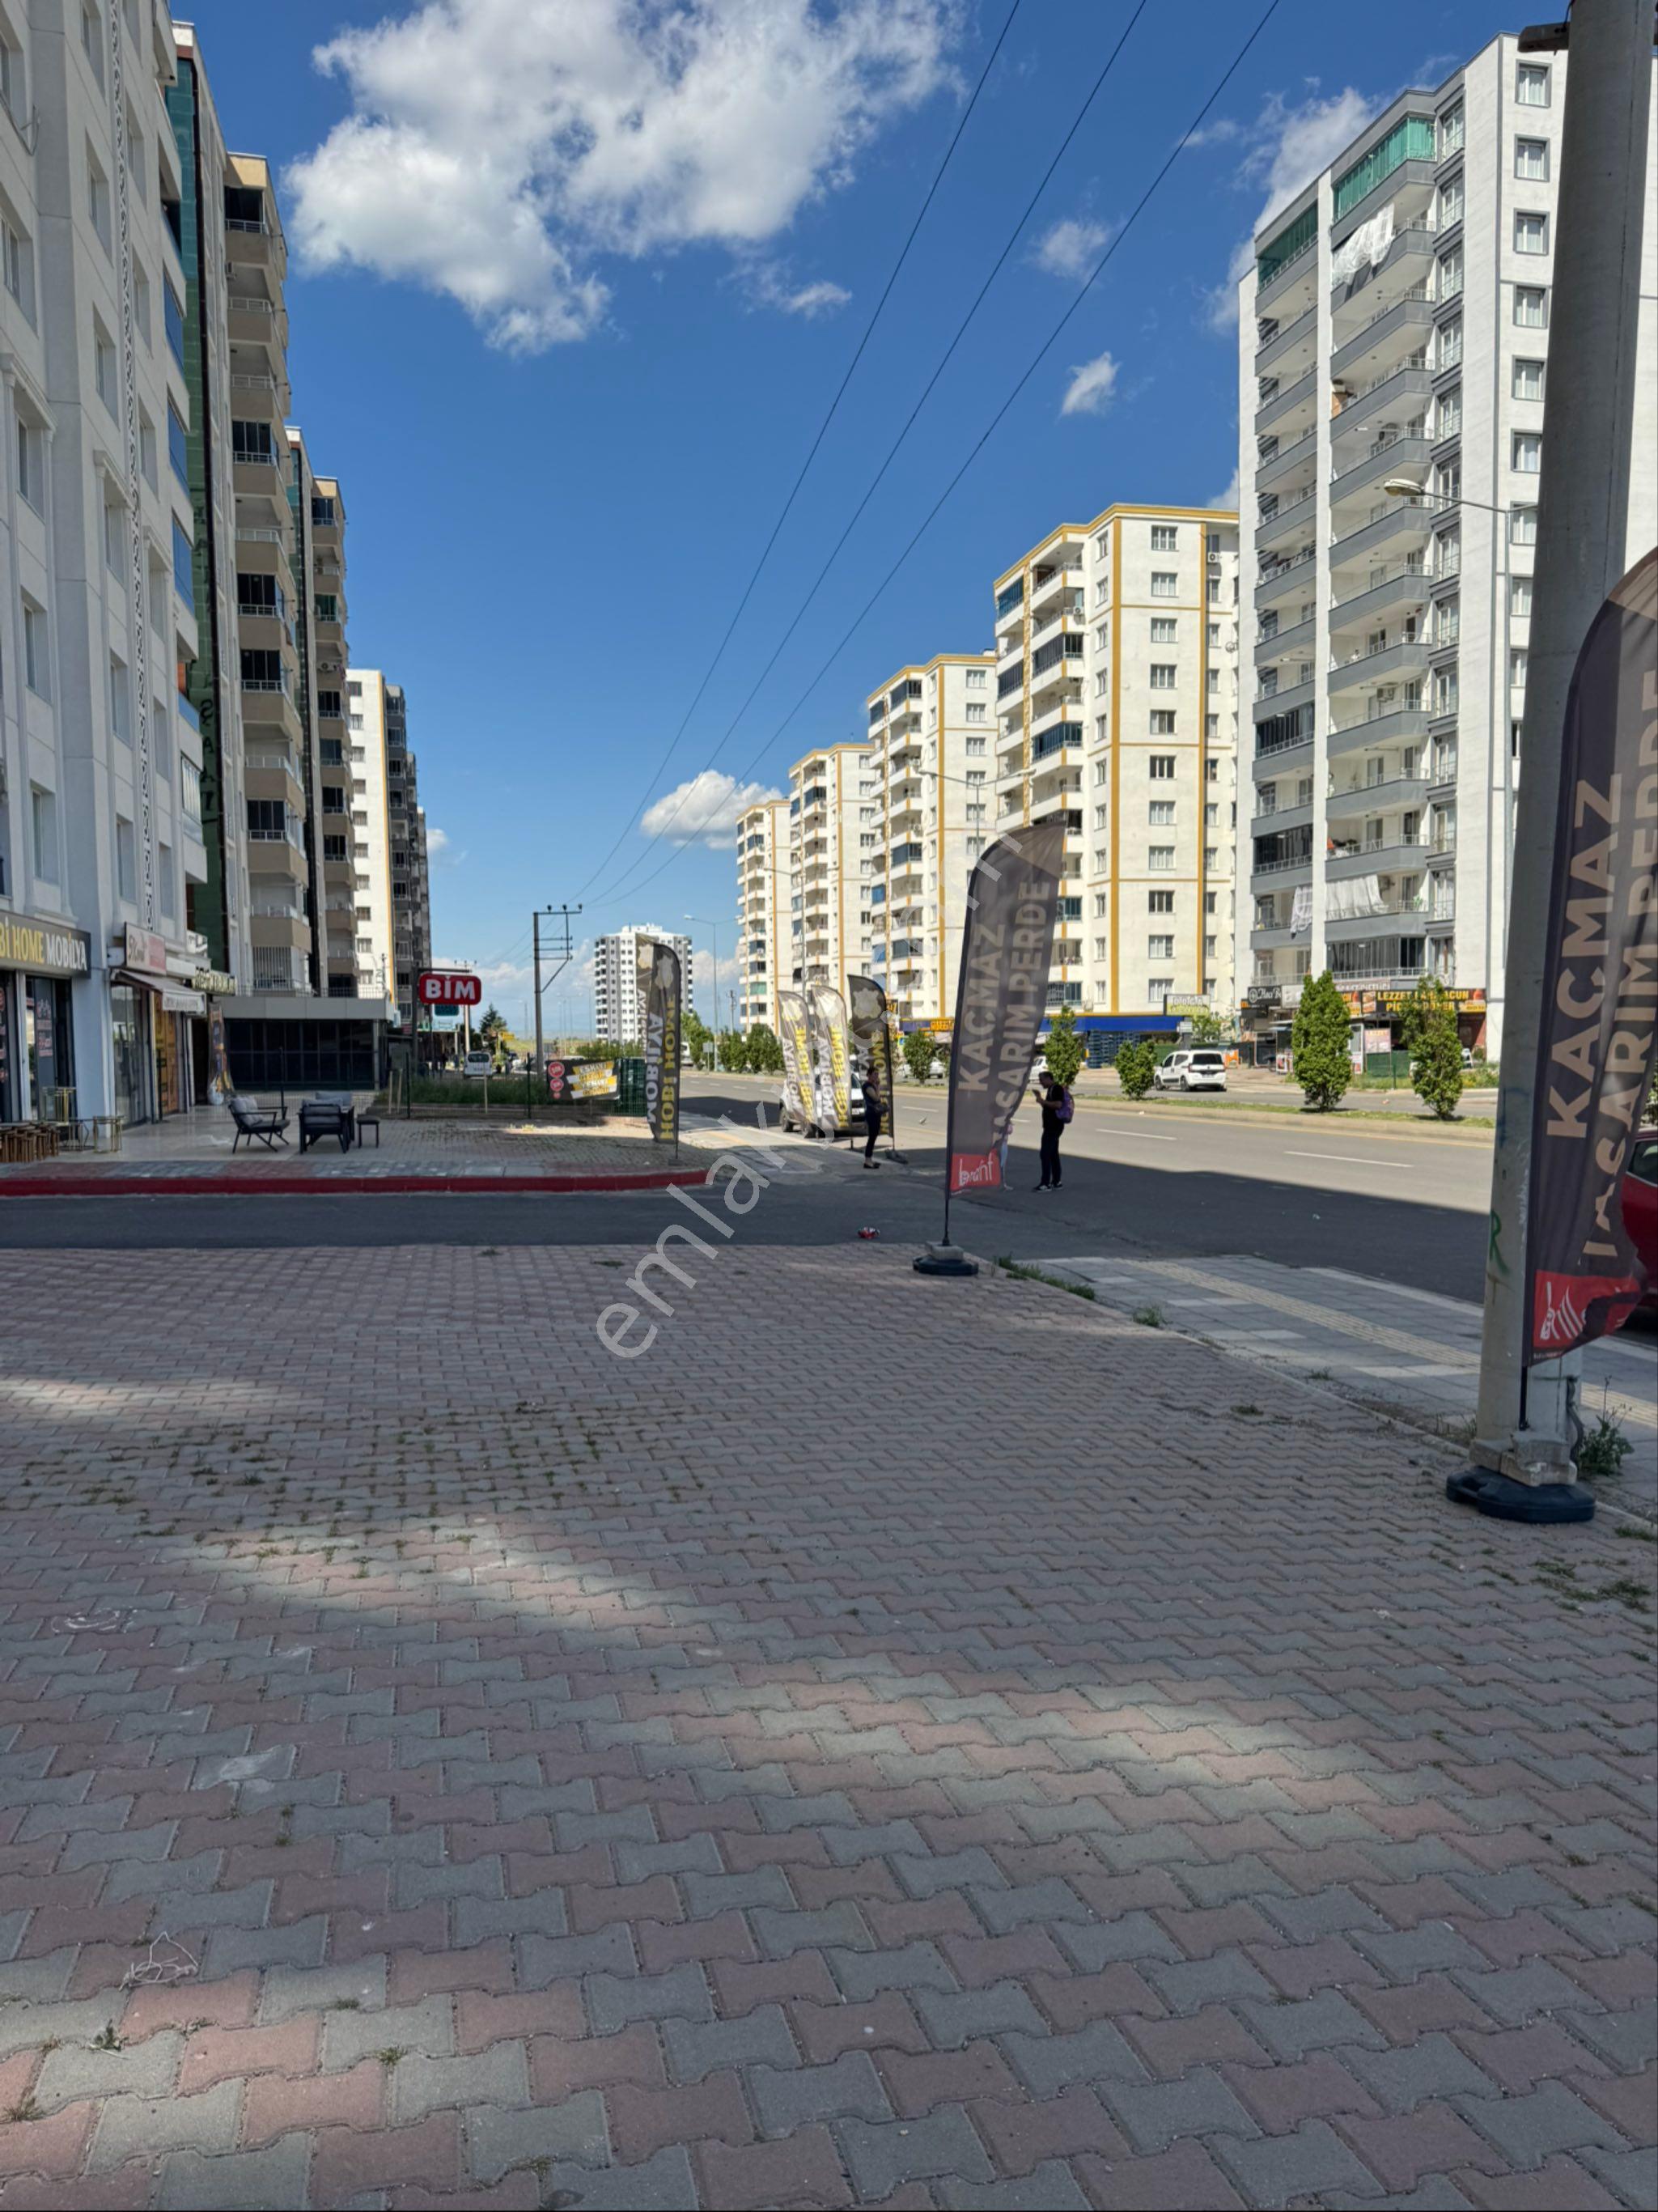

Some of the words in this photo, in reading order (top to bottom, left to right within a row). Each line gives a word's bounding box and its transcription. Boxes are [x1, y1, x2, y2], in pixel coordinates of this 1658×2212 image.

[12, 925, 45, 965] HOME
[46, 932, 87, 971] MOBİLYA
[1007, 881, 1050, 993] PERDE
[425, 975, 476, 1000] BİM
[1377, 991, 1412, 1001] LEZZET
